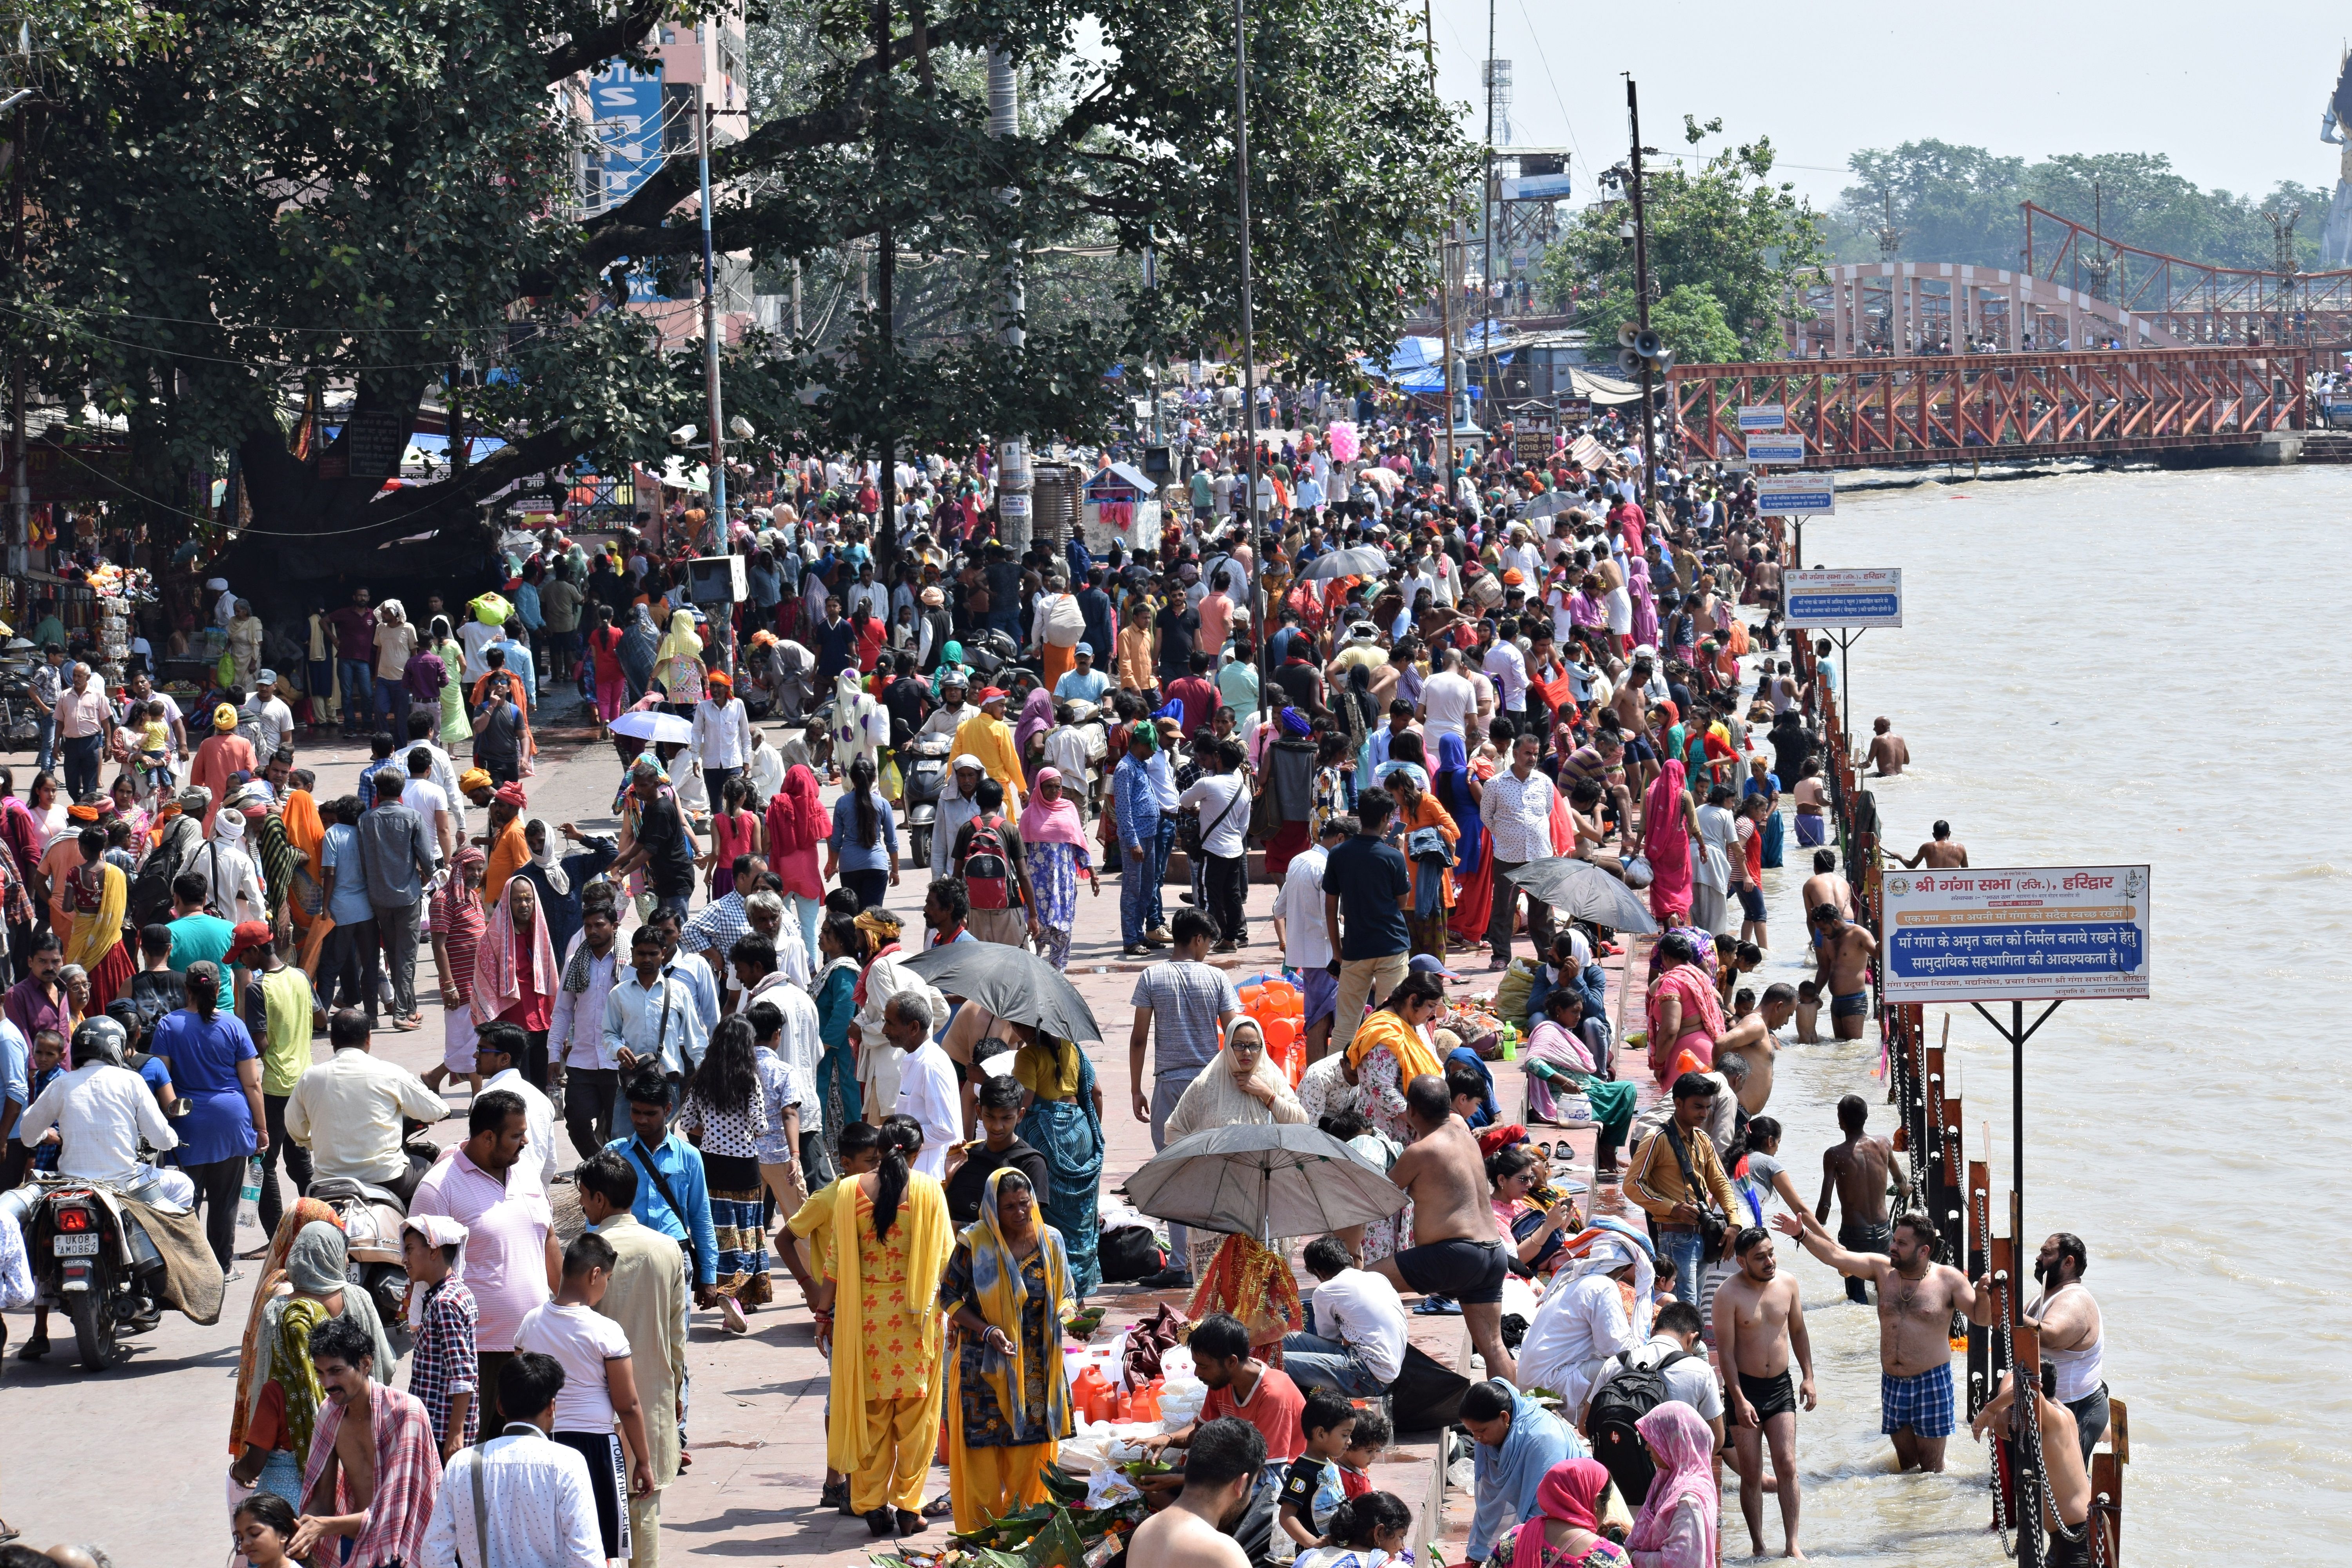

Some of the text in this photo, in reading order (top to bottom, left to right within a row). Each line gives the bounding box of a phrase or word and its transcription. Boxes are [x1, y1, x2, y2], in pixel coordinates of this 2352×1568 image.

[587, 63, 659, 83] OTEL
[1517, 434, 1539, 443] शताब्दी
[1915, 876, 1935, 892] श्री
[1939, 876, 1974, 891] गंगा
[1978, 878, 2012, 891] सभा
[2062, 873, 2114, 890] हरिद्वार
[1904, 915, 1921, 924] एक
[1966, 911, 1993, 920] अपनी
[1995, 910, 2007, 920] माँ
[2008, 910, 2027, 919] गंगा
[2028, 909, 2043, 919] को
[2044, 909, 2068, 919] सदैव
[1898, 927, 2136, 951] माँ गंगा के अमृत जल को निर्मल बनाये रखने हेतु
[1911, 953, 1969, 973] सामुदायिक
[1971, 951, 2026, 969] सहभागिता
[2027, 950, 2044, 965] की
[2046, 953, 2107, 966] आवश्यकता
[64, 1214, 78, 1228] A
[66, 1235, 90, 1245] UK08
[60, 1245, 96, 1254] AM0862
[1612, 1431, 1619, 1444] hp
